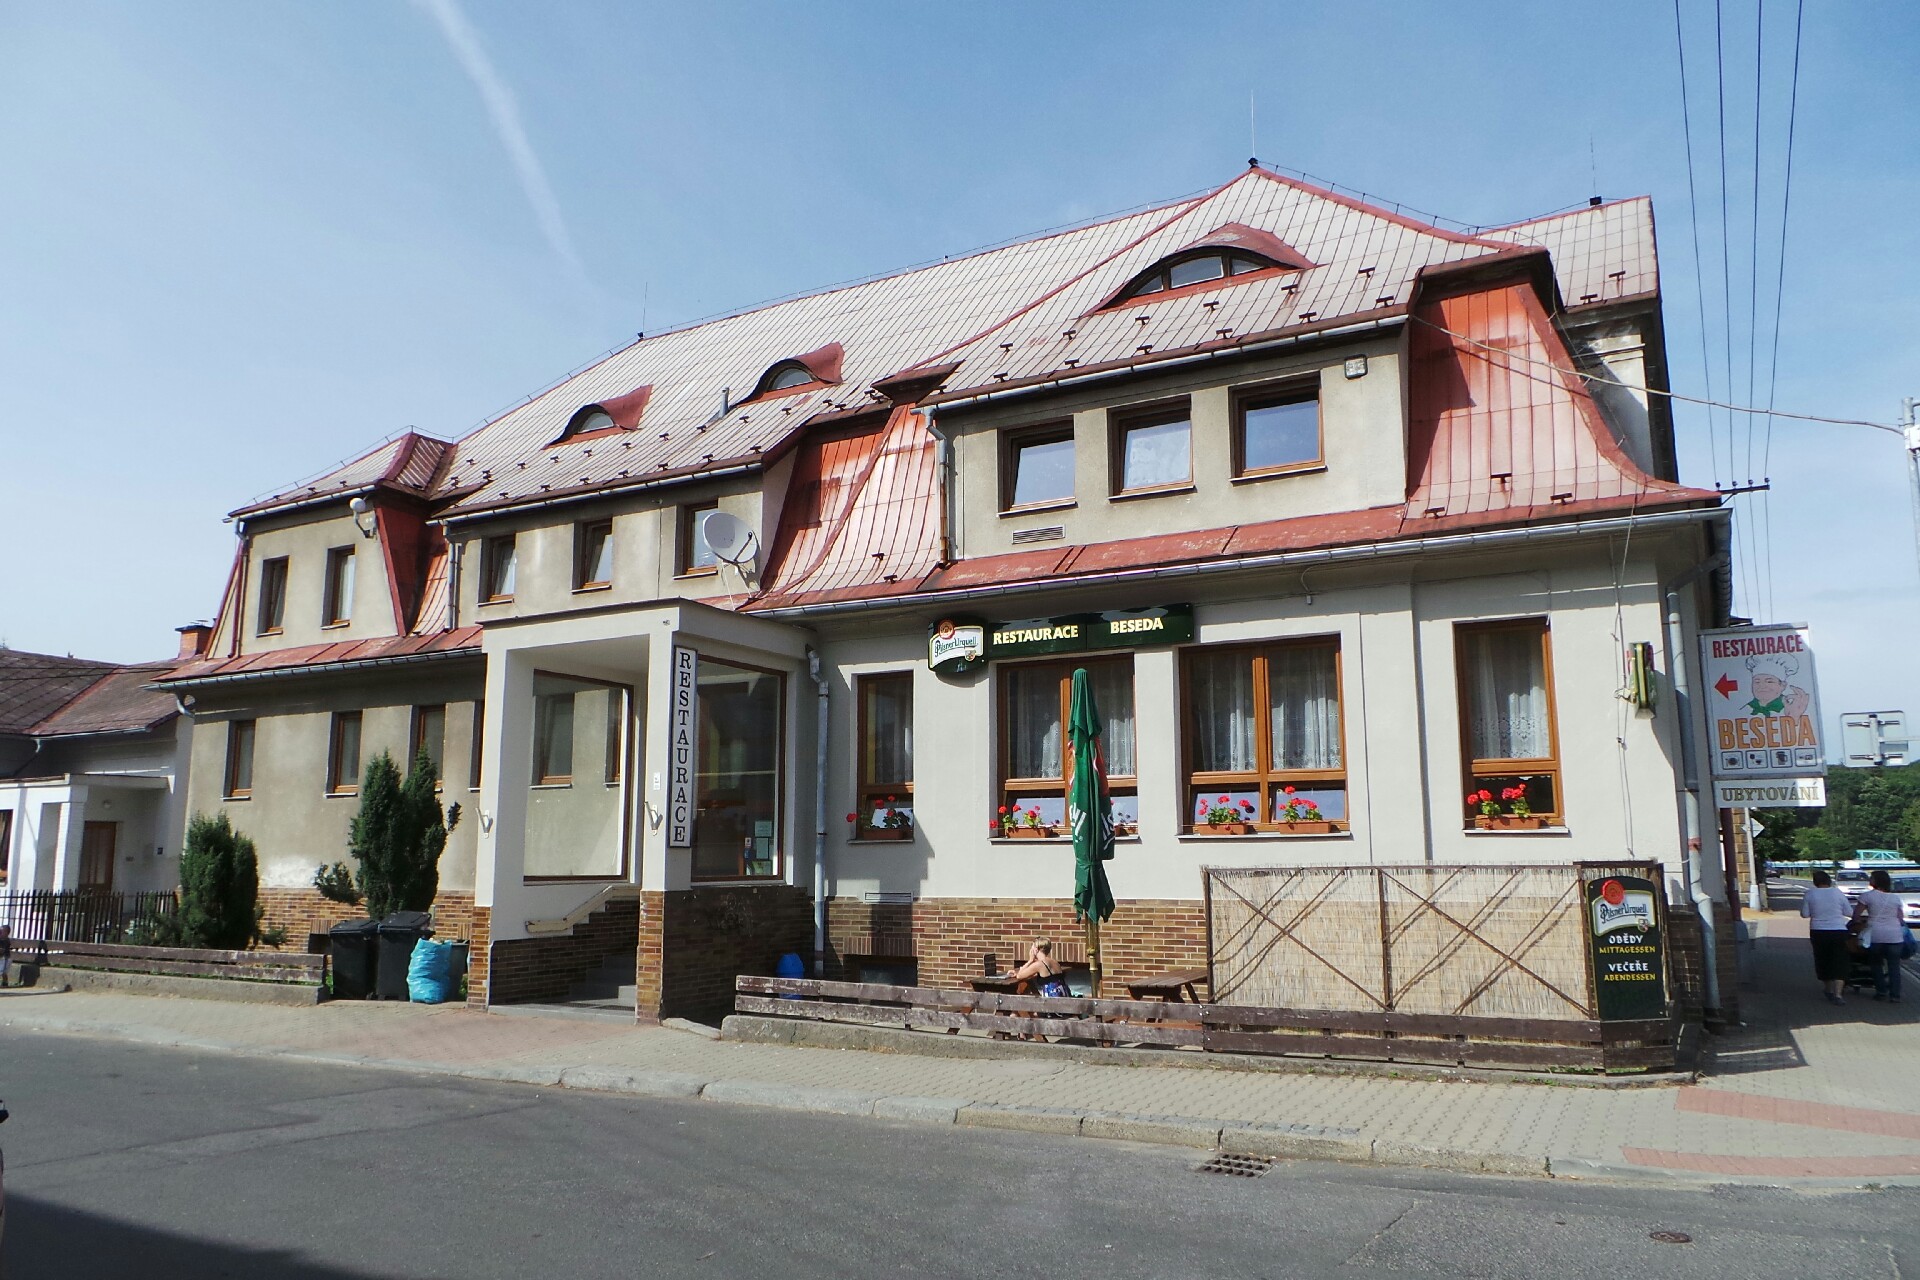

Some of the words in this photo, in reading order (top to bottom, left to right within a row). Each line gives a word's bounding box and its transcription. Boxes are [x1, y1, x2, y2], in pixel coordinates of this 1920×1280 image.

[993, 625, 1079, 645] RESTAURACE
[1110, 617, 1164, 634] BESEDA
[935, 640, 954, 657] Pilsner
[954, 637, 977, 649] Urquell
[1712, 635, 1804, 658] RESTAURACE
[1718, 715, 1817, 750] BESEDA
[674, 652, 691, 842] RESTAURACE
[1721, 783, 1819, 802] UBYTOVÁNÍ
[1600, 903, 1624, 924] Pilsner
[1623, 903, 1648, 917] Urquell
[1609, 933, 1643, 943] OBĚDY
[1608, 960, 1648, 971] VEČEŘE
